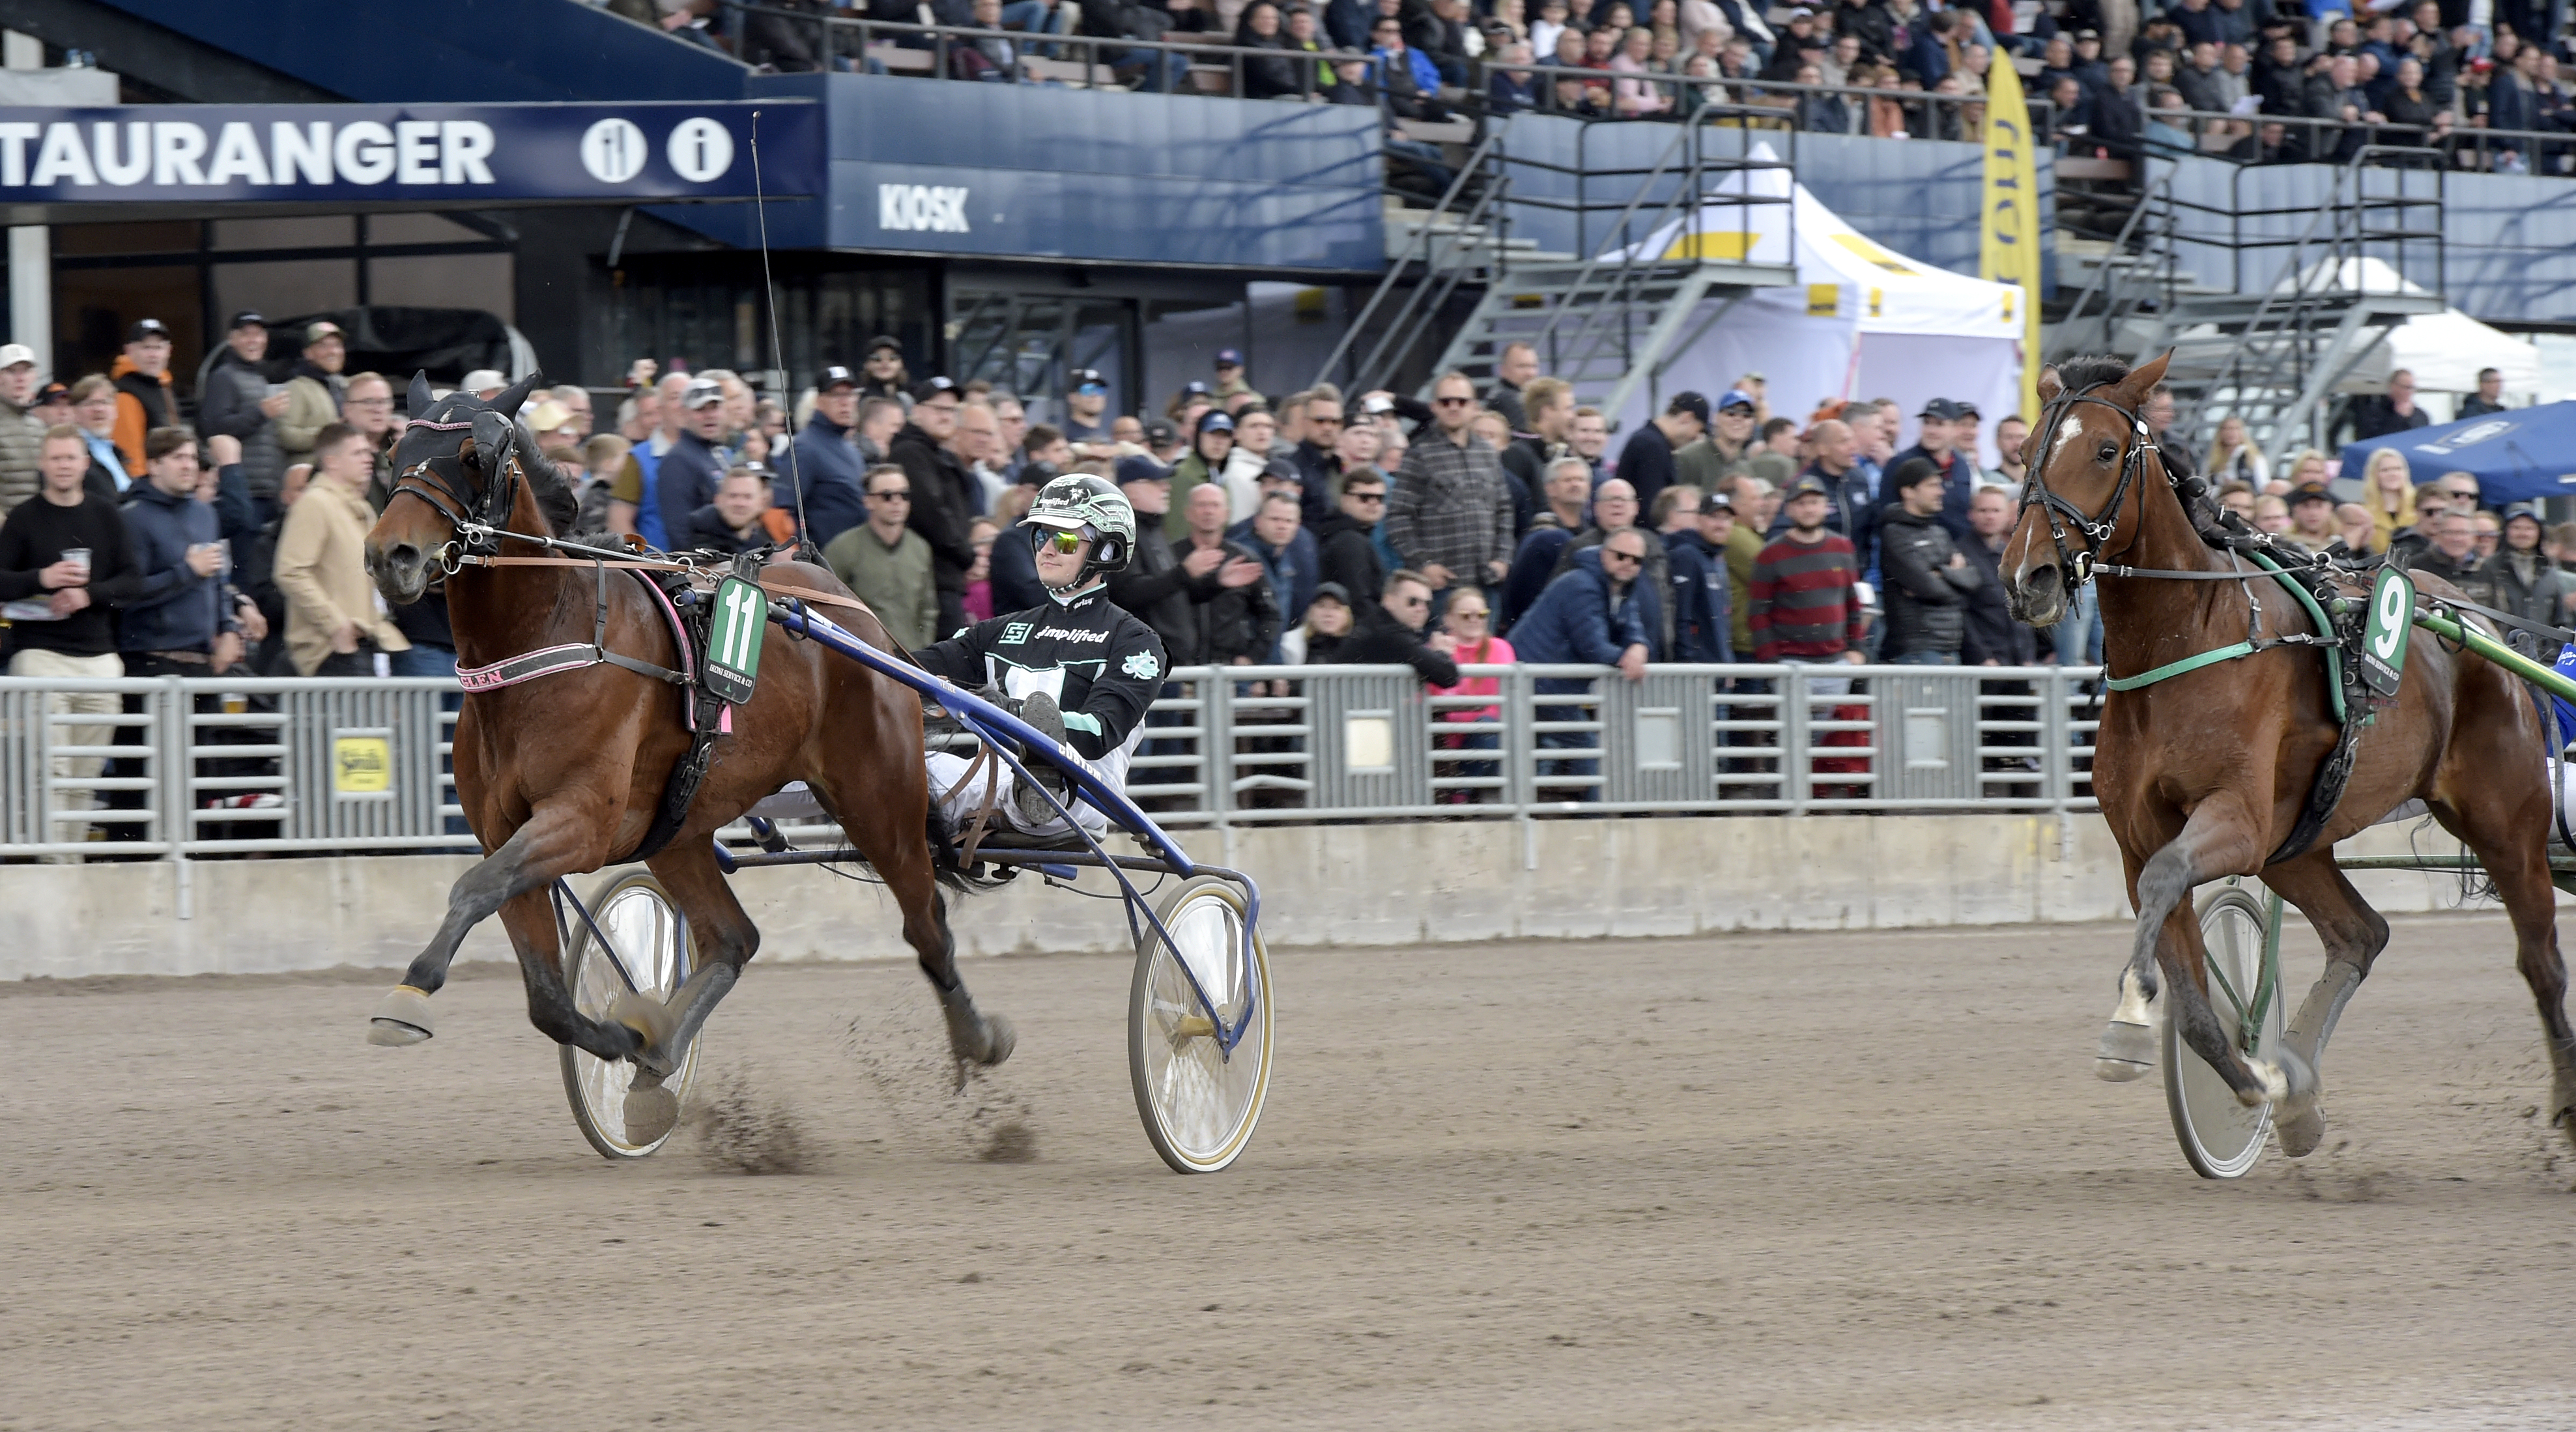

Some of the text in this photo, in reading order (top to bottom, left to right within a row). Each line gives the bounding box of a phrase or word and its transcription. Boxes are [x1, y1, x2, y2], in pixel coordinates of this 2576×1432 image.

[0, 121, 496, 185] TAURANGER
[879, 183, 971, 233] KIOSK
[722, 583, 758, 671] 11
[2375, 575, 2406, 659] 9
[723, 669, 742, 683] SERVICE
[741, 677, 746, 685] &
[745, 678, 752, 688] CO
